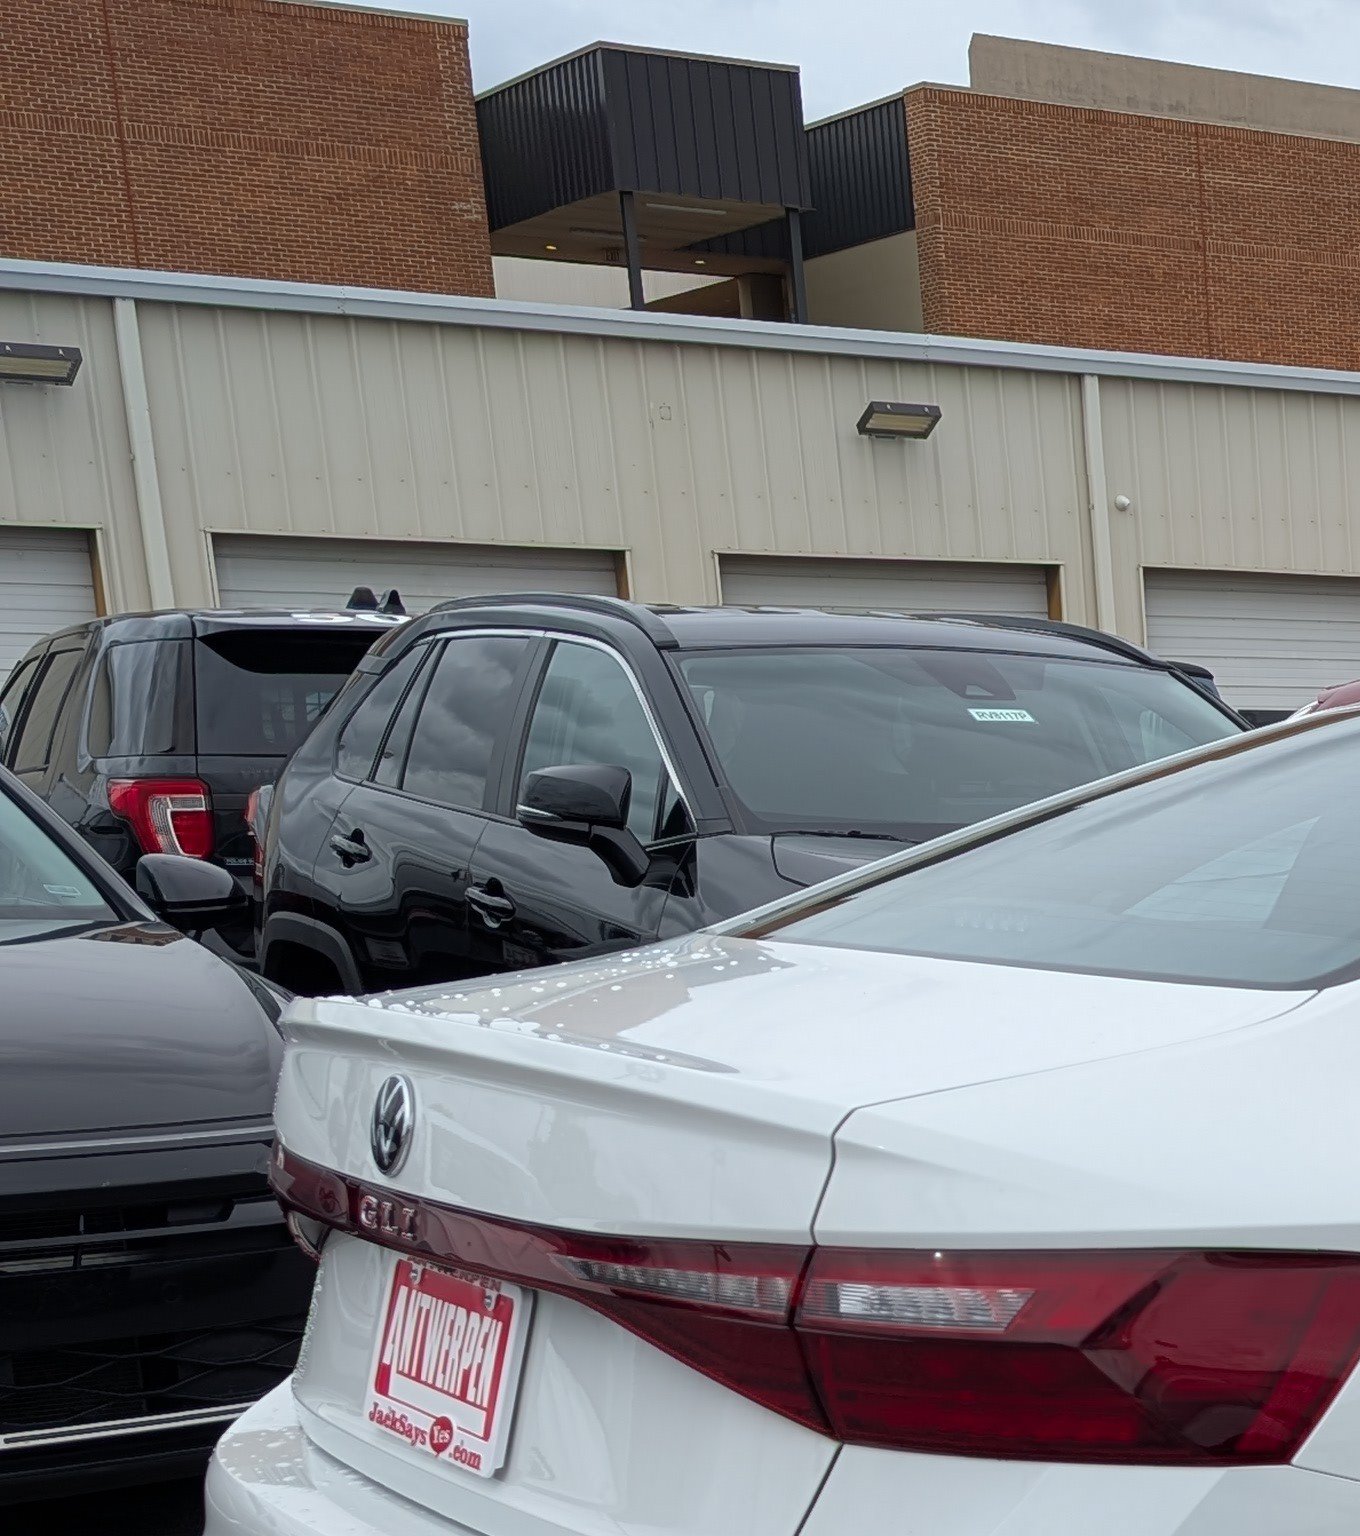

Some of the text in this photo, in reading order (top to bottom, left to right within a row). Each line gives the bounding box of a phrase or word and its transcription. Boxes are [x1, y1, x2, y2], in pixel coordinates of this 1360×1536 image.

[361, 1195, 416, 1241] GLI
[383, 1285, 503, 1408] ANTWERPEN
[431, 1424, 451, 1444] Yes
